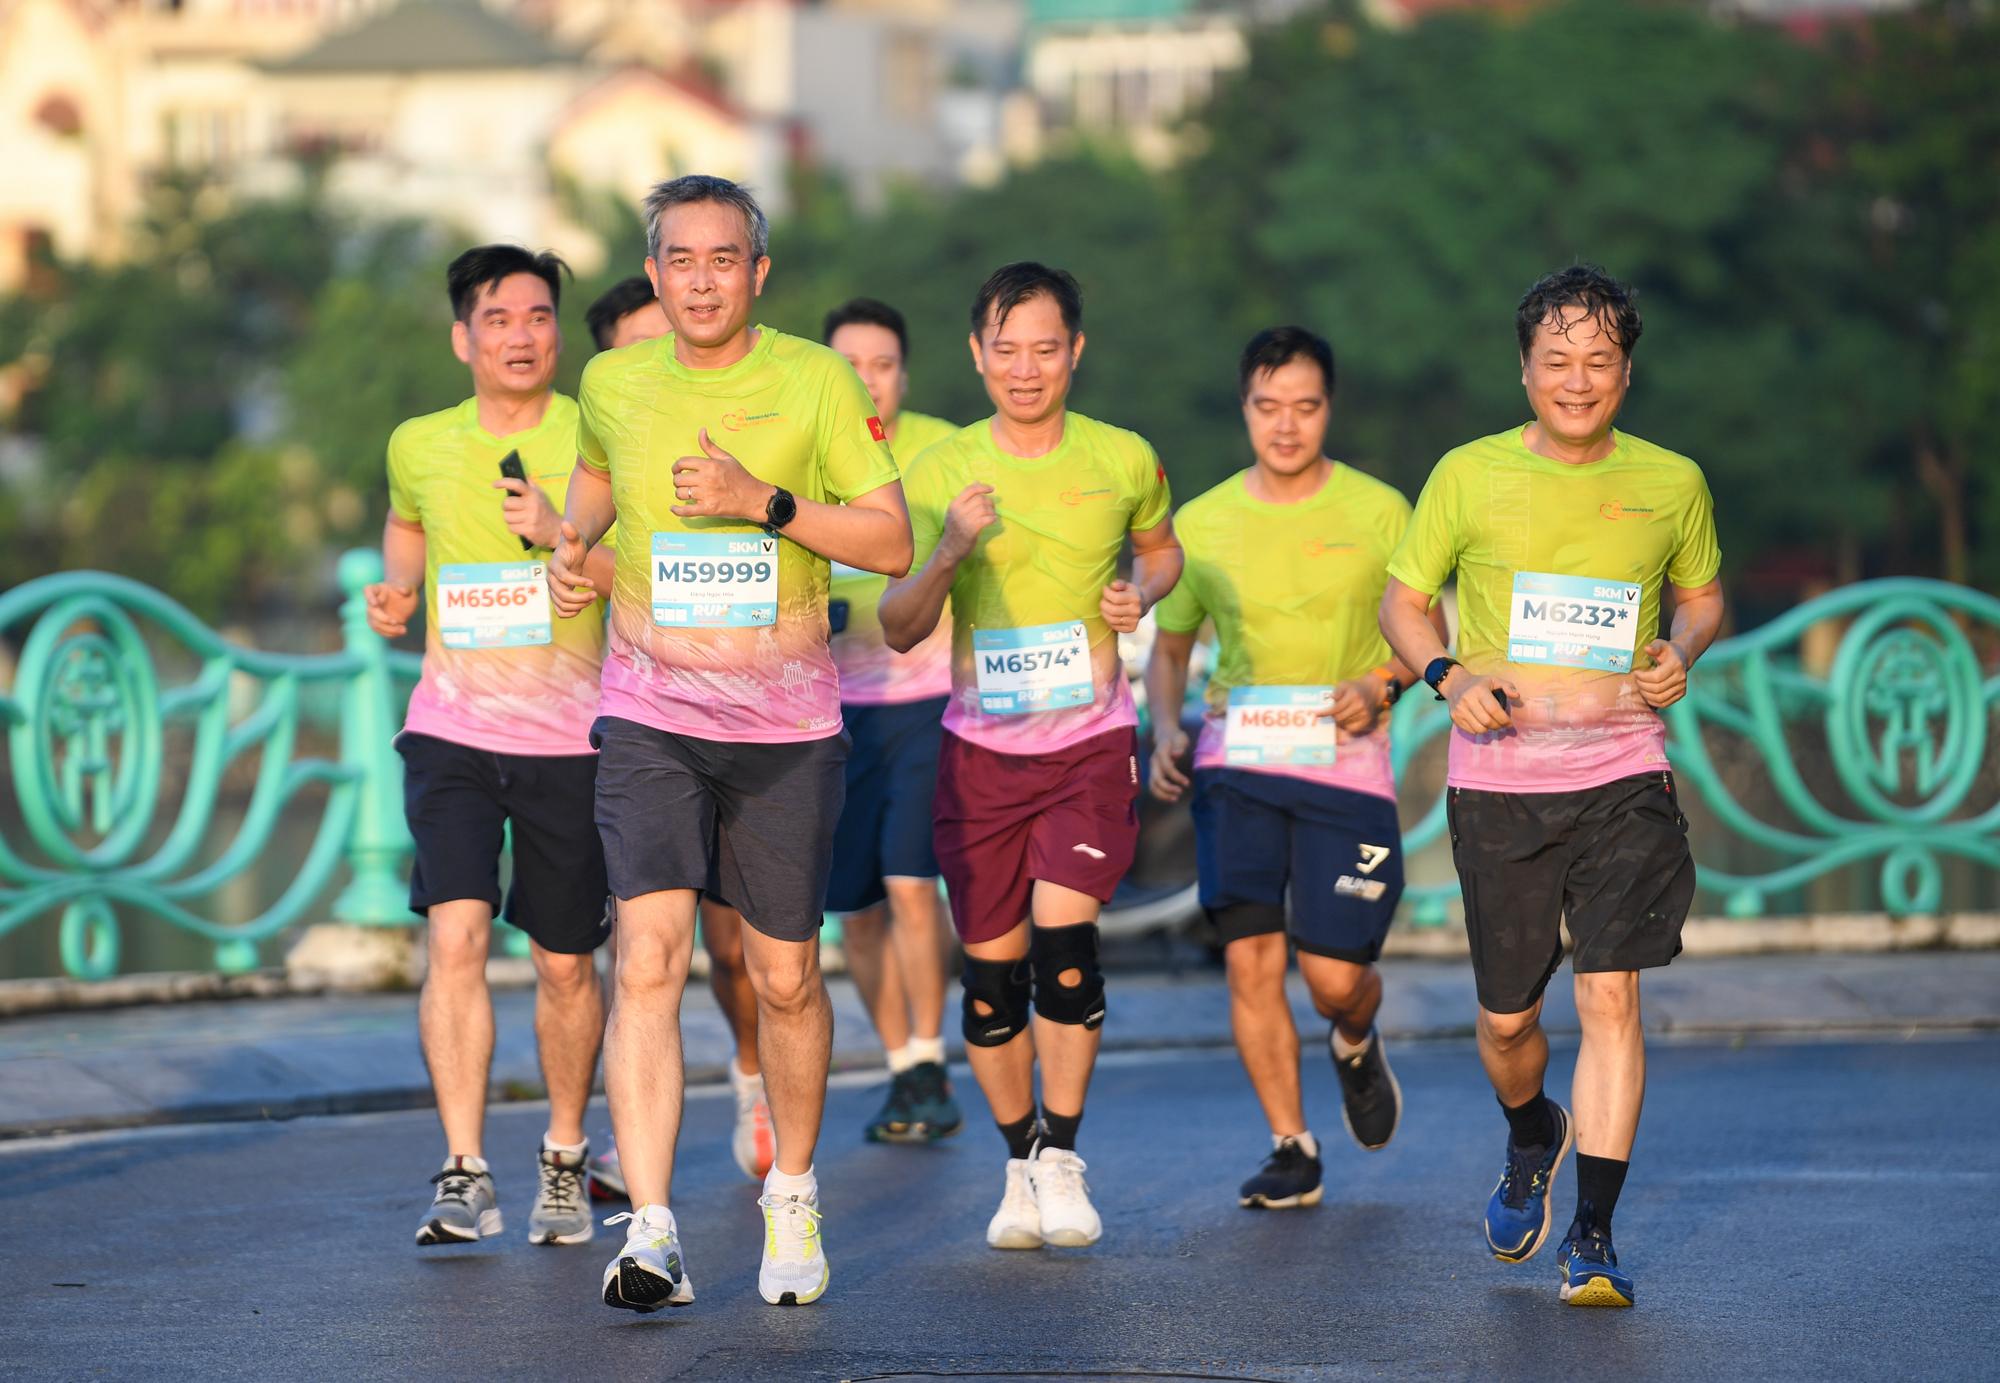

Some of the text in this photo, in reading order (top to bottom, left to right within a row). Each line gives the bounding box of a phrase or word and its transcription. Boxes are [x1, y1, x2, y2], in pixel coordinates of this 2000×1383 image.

[728, 541, 773, 553] 5KM V
[533, 567, 542, 577] P
[658, 561, 771, 583] M59999
[1593, 586, 1637, 601] 5KM V
